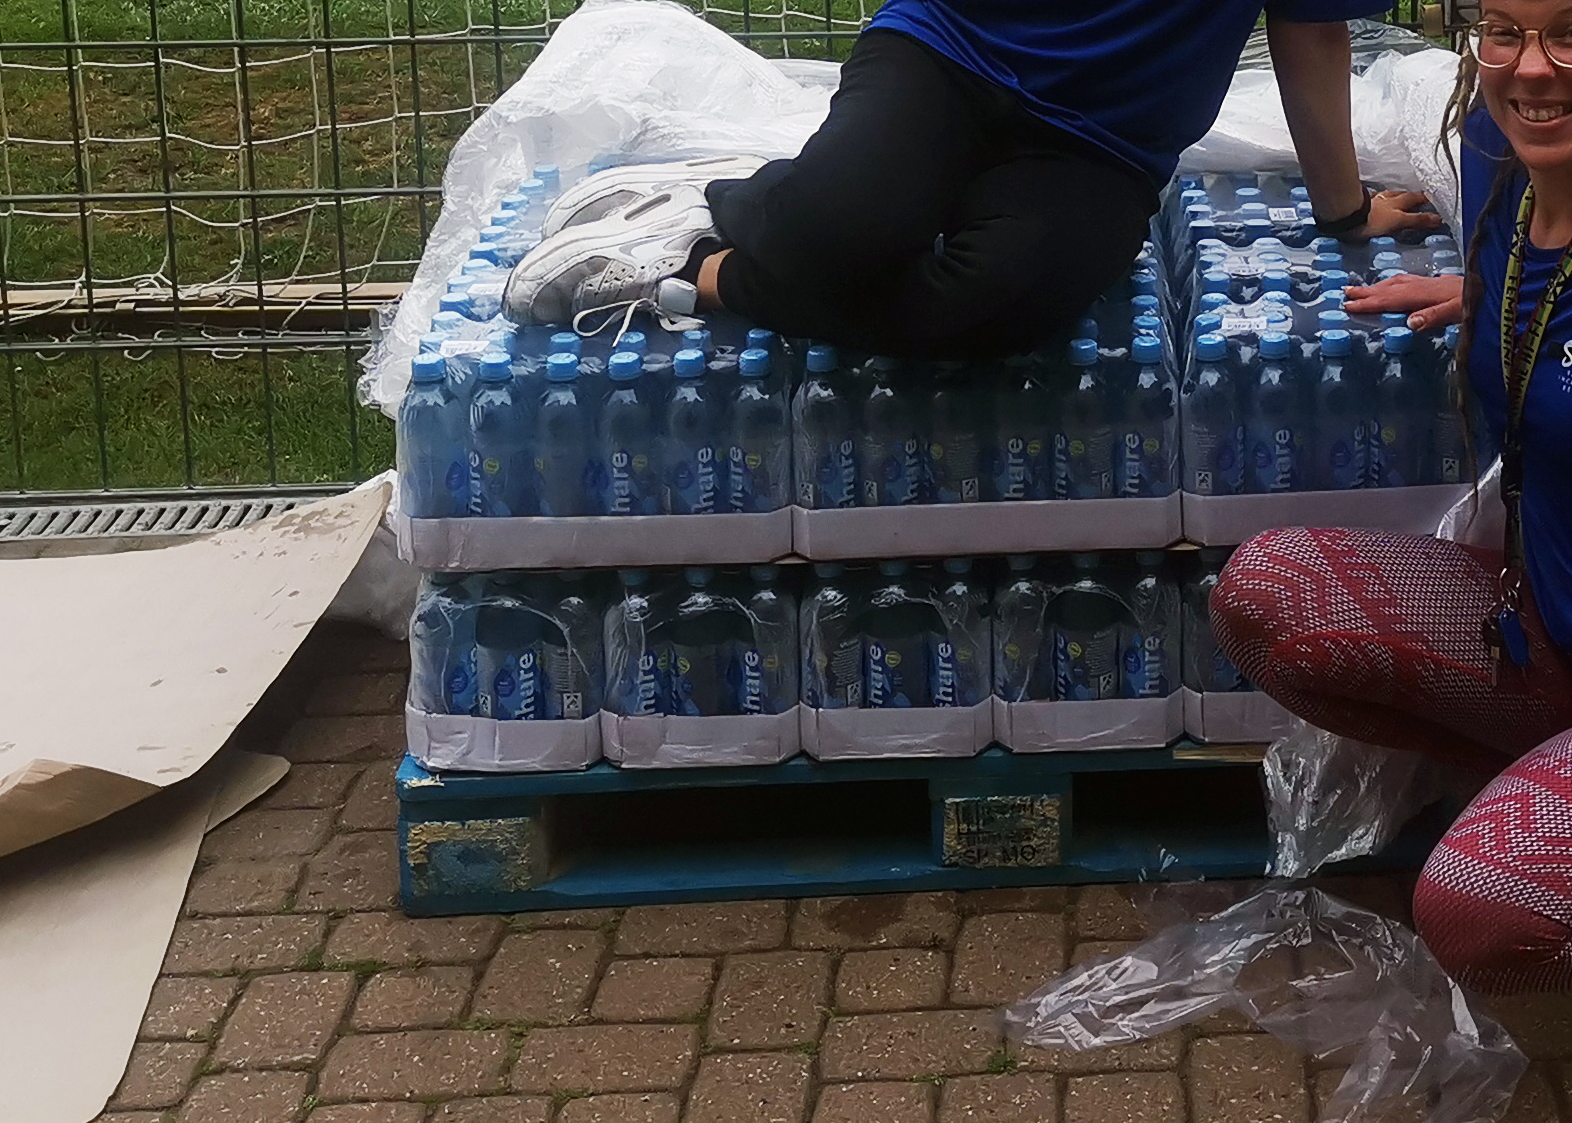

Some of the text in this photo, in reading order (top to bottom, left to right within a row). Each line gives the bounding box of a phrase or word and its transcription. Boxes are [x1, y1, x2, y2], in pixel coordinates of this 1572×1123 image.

[467, 450, 482, 515] hare
[611, 452, 629, 513] hare
[729, 446, 743, 513] hare
[1004, 437, 1024, 498] hare
[1121, 432, 1139, 498] hare
[1270, 429, 1291, 489] hare
[636, 652, 656, 715] hare
[743, 651, 762, 715] hare
[869, 645, 883, 708] hare
[1139, 636, 1161, 696] hare
